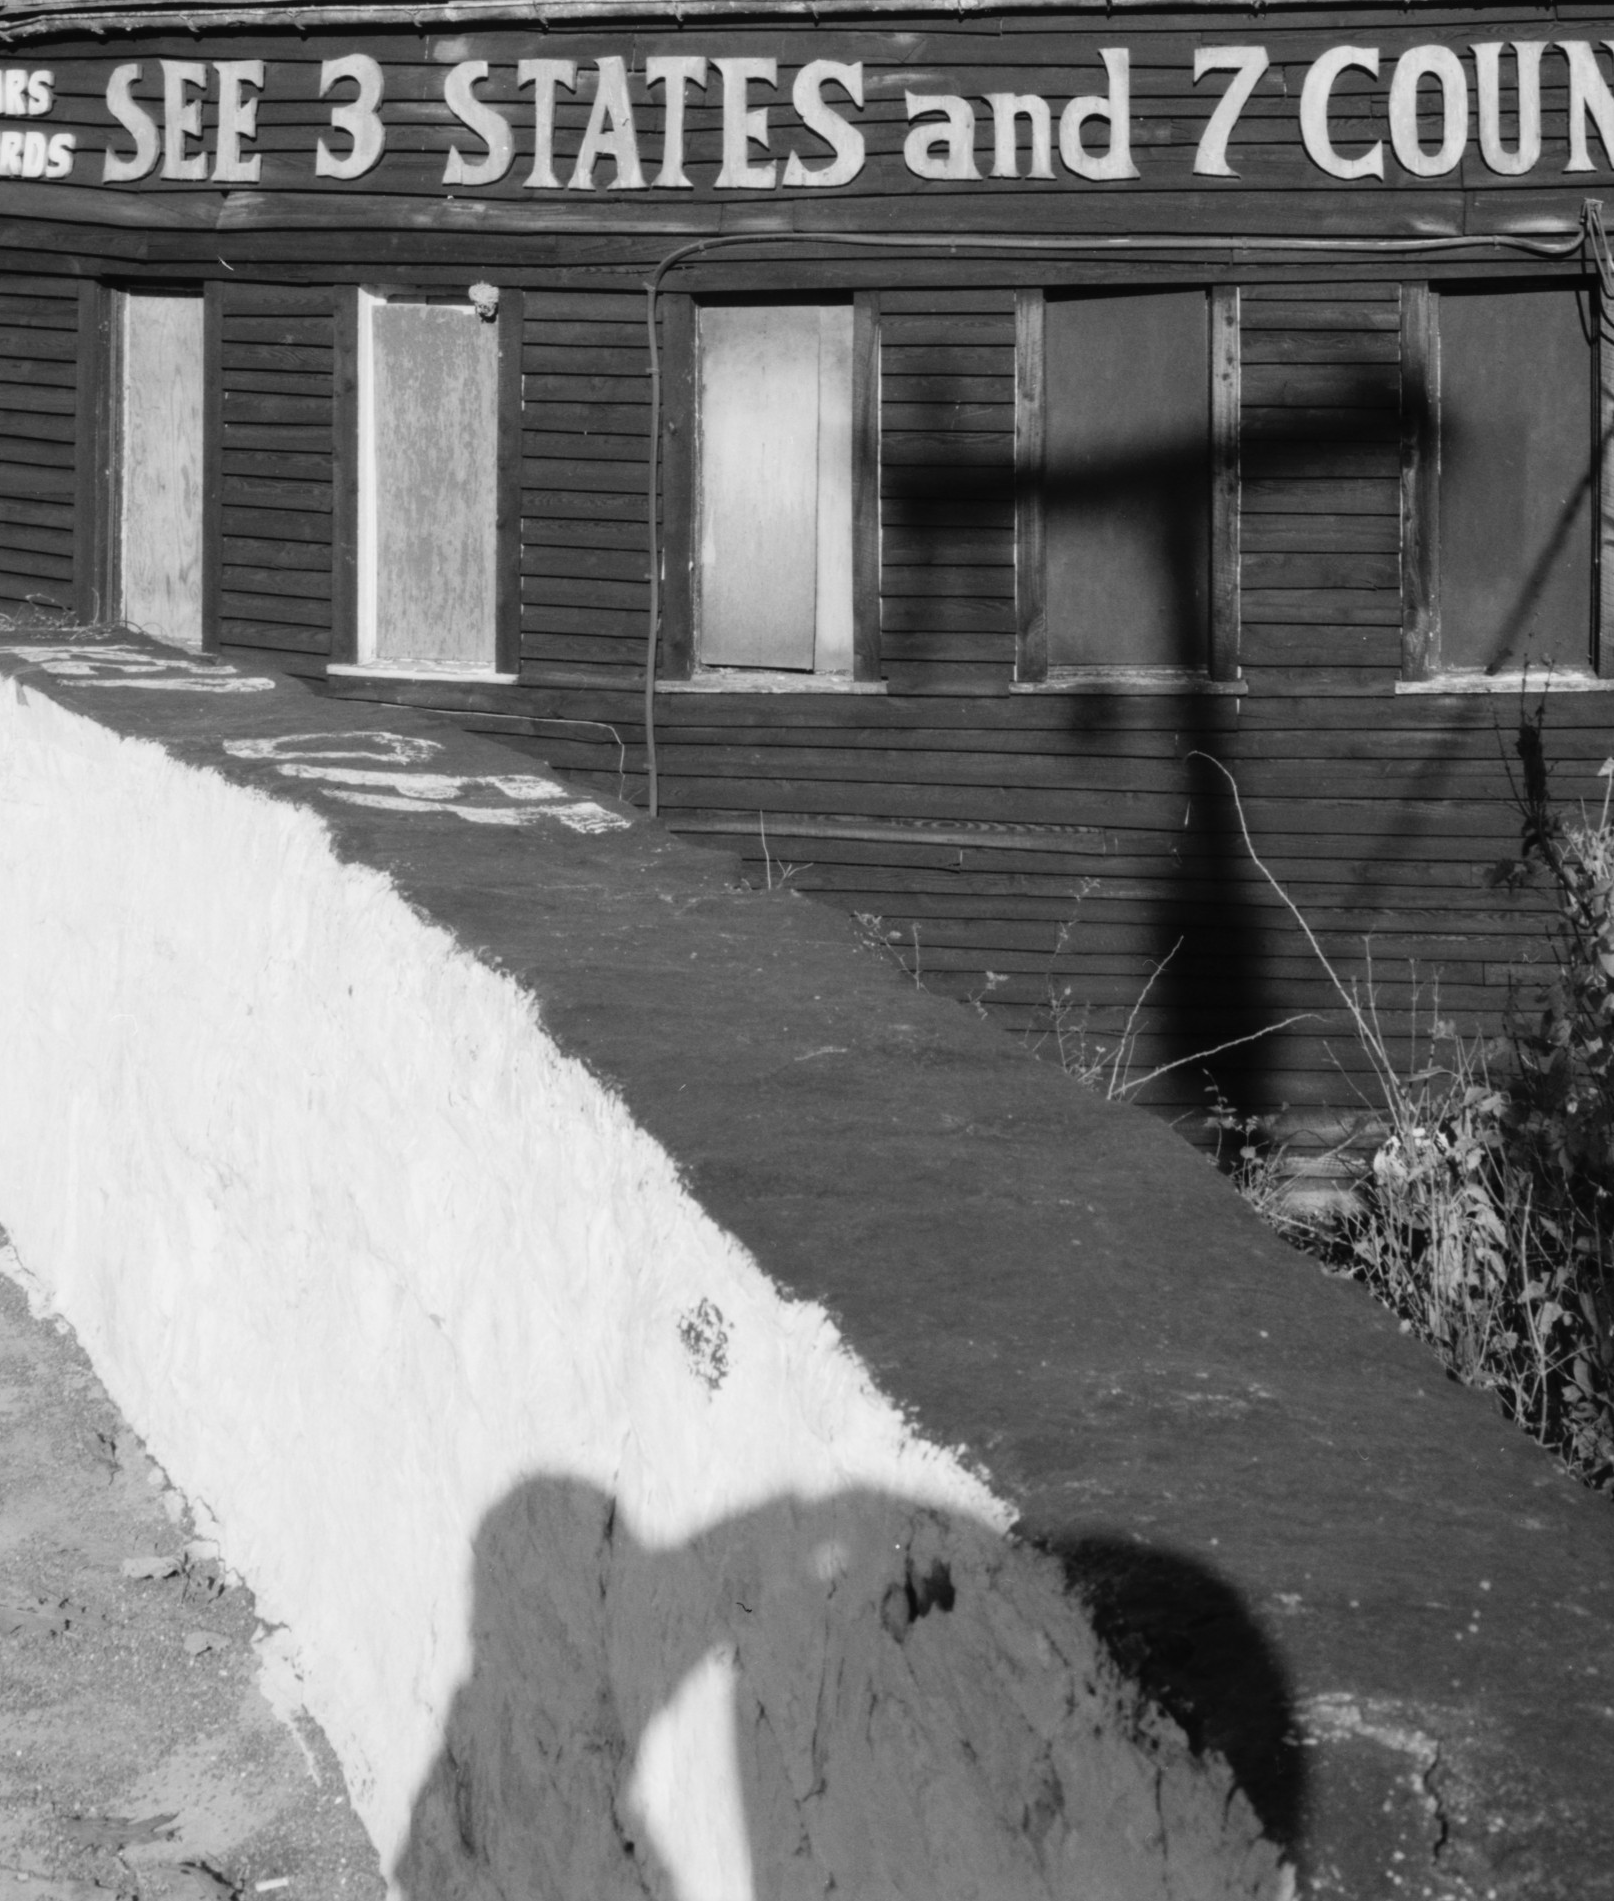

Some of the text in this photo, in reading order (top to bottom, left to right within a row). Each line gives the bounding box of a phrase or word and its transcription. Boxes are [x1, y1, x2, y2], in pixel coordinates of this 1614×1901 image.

[102, 57, 266, 185] SEE
[315, 52, 386, 180] 3
[440, 55, 866, 191] STATES
[902, 47, 1141, 183] and
[1192, 45, 1271, 179] 7
